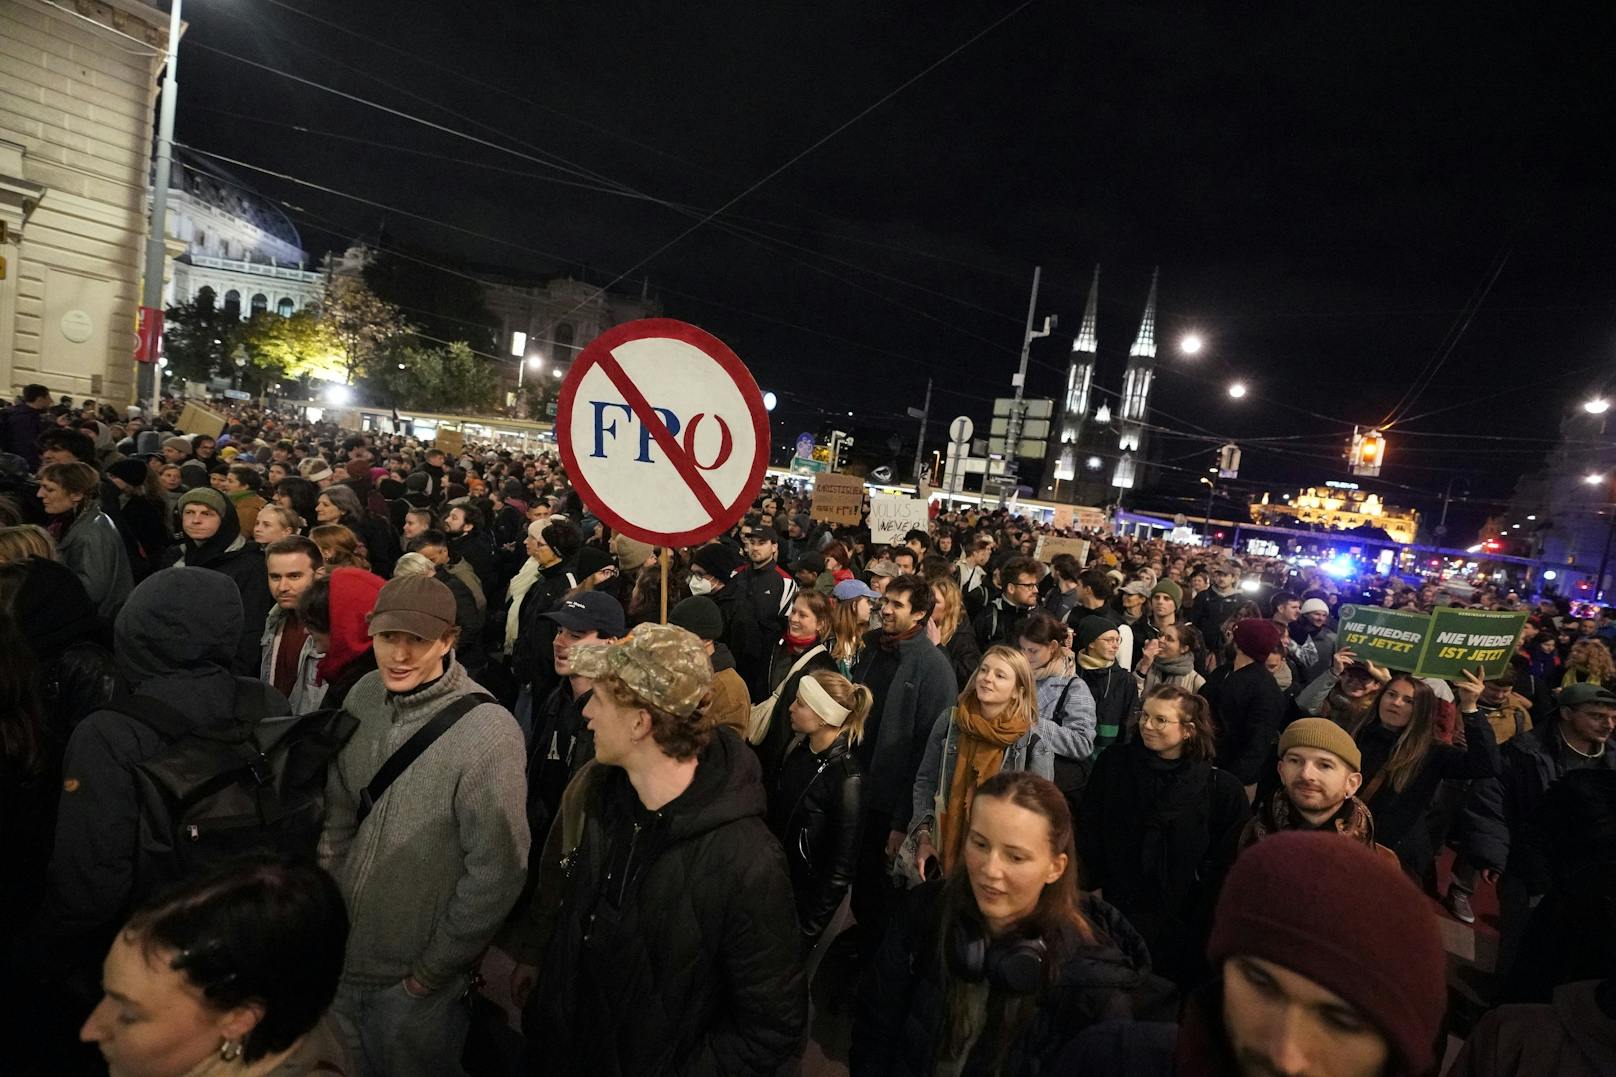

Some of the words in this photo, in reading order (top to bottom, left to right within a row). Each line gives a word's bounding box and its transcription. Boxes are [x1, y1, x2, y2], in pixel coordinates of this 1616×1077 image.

[1344, 622, 1366, 633] NIE
[1366, 625, 1422, 643] WIEDER
[1436, 631, 1467, 645] NIE
[1467, 634, 1514, 647] WIEDER
[1345, 633, 1368, 645] IST
[1368, 637, 1414, 653] JETZT
[1438, 646, 1468, 660] IST
[1467, 648, 1506, 661] JETZT
